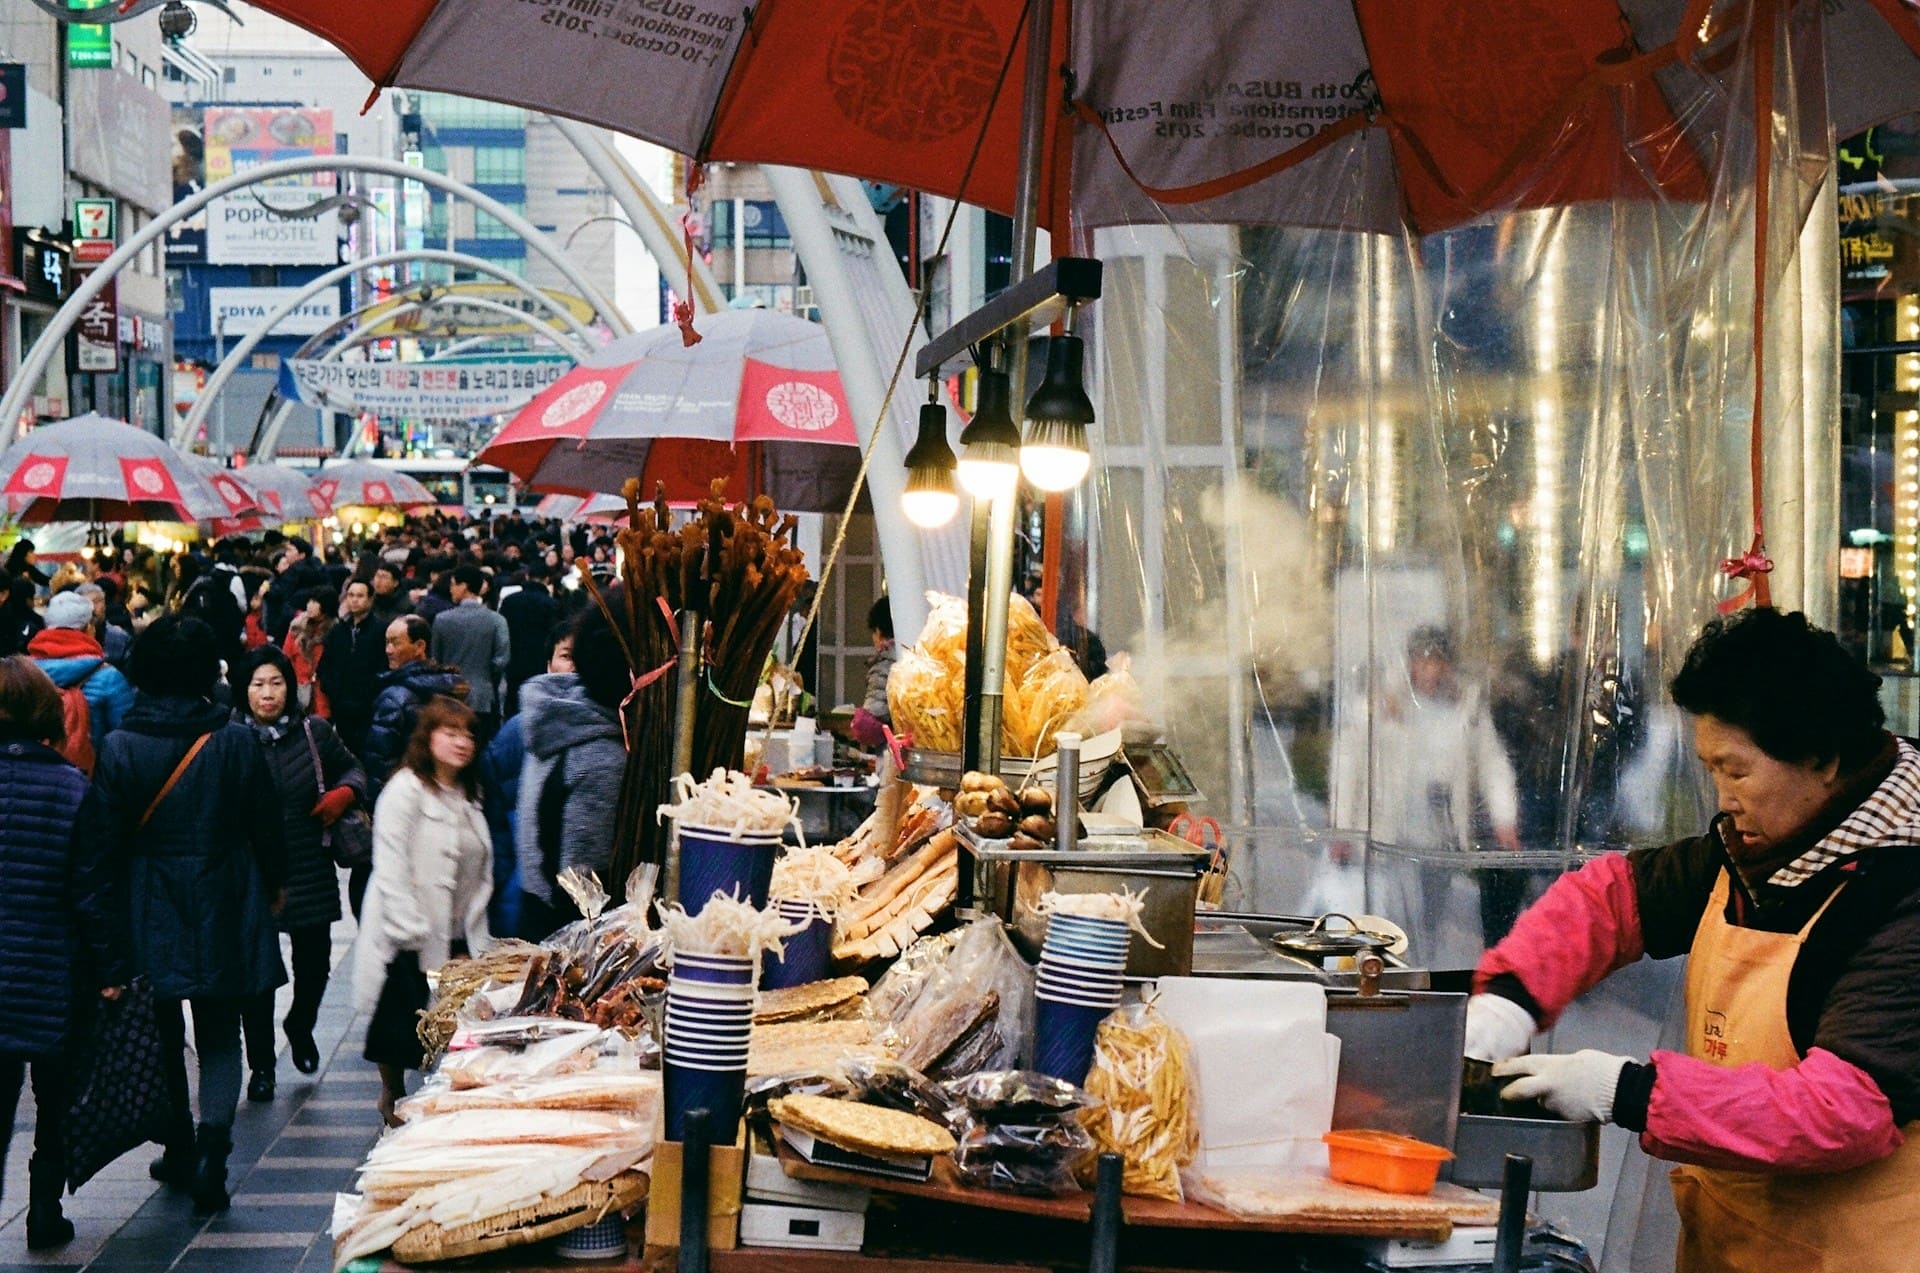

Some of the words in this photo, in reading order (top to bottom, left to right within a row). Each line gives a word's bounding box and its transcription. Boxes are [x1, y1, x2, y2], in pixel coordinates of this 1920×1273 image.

[253, 226, 317, 241] HOSTEL
[345, 367, 380, 388] 당신의
[473, 369, 508, 389] 노리고
[511, 365, 561, 389] 있습니다
[353, 392, 413, 402] Beware
[419, 393, 509, 405] Pickpocket
